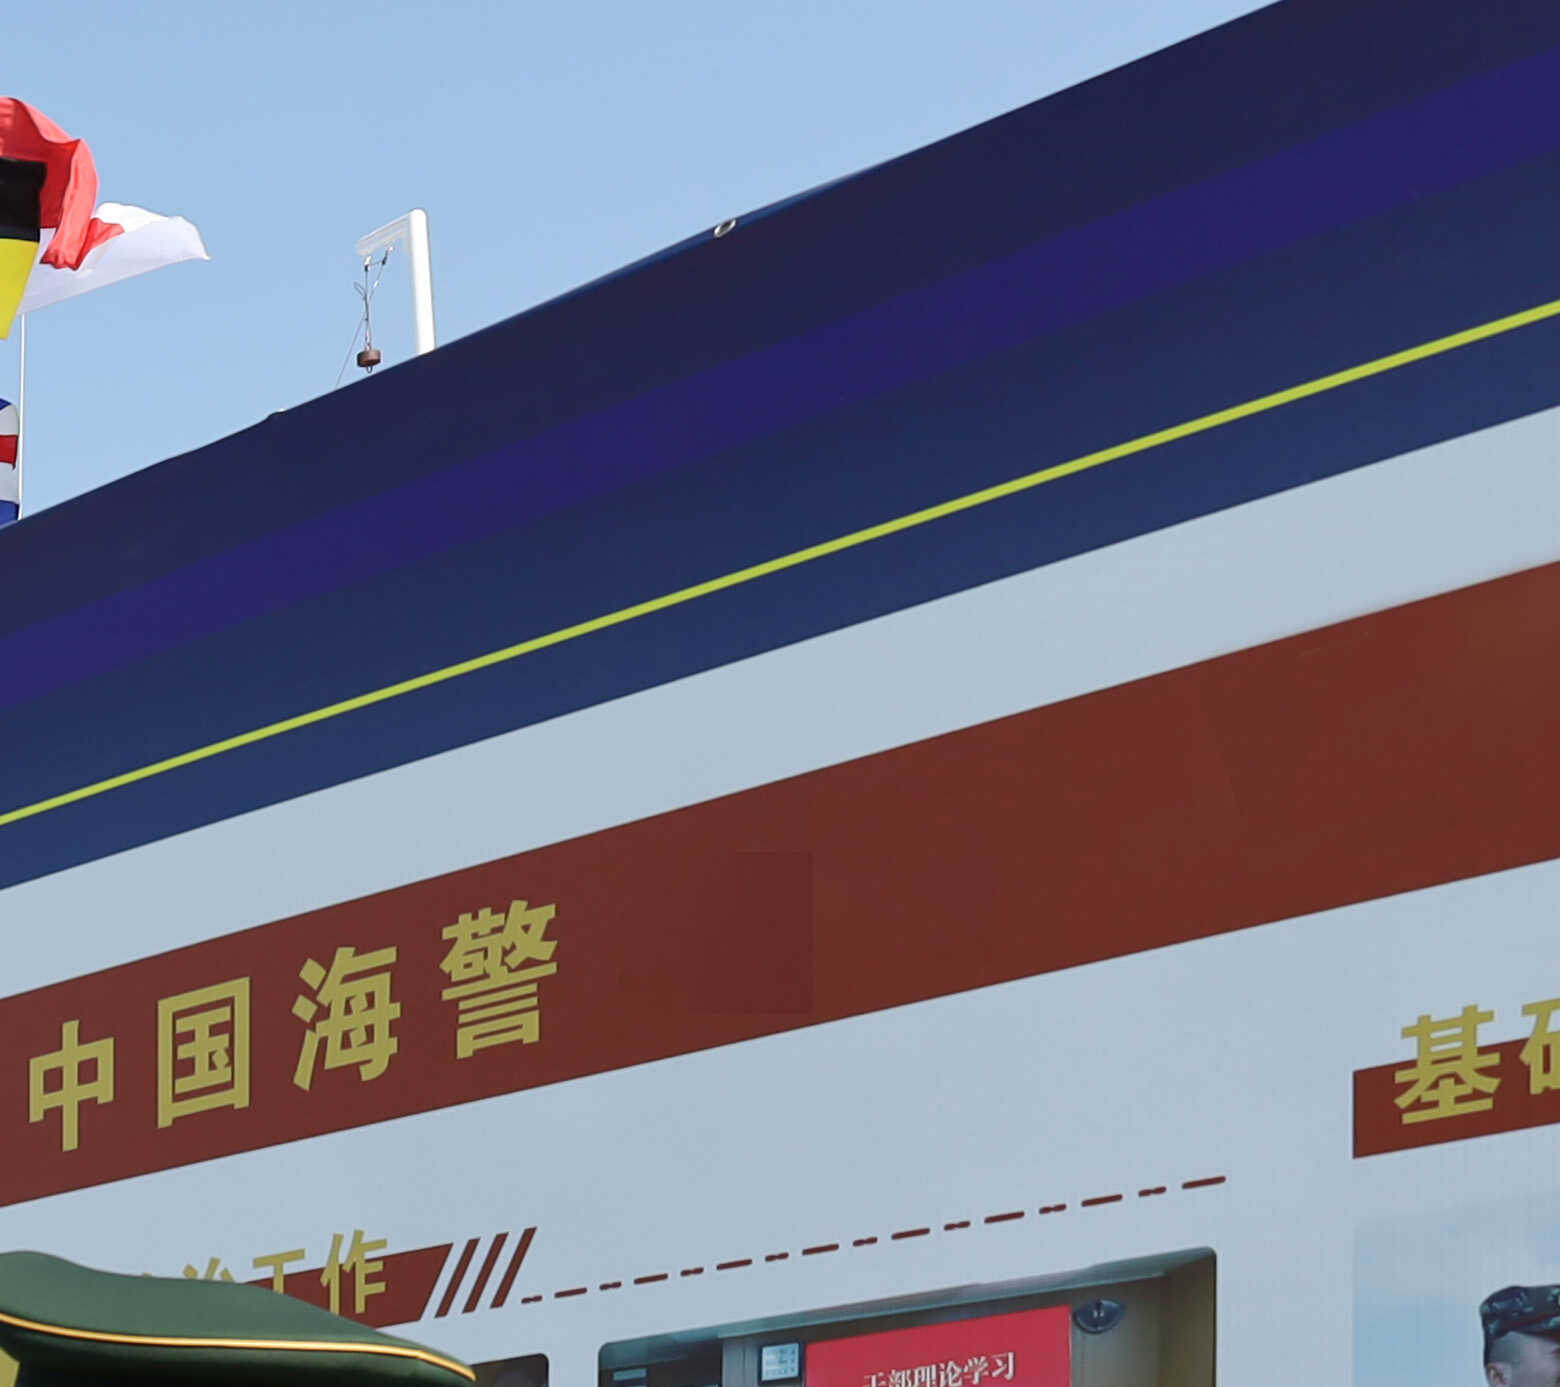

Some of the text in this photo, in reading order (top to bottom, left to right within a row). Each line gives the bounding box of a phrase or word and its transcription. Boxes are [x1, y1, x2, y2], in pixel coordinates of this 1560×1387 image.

[27, 899, 559, 1153] 中国海警
[182, 1229, 388, 1316] 工作
